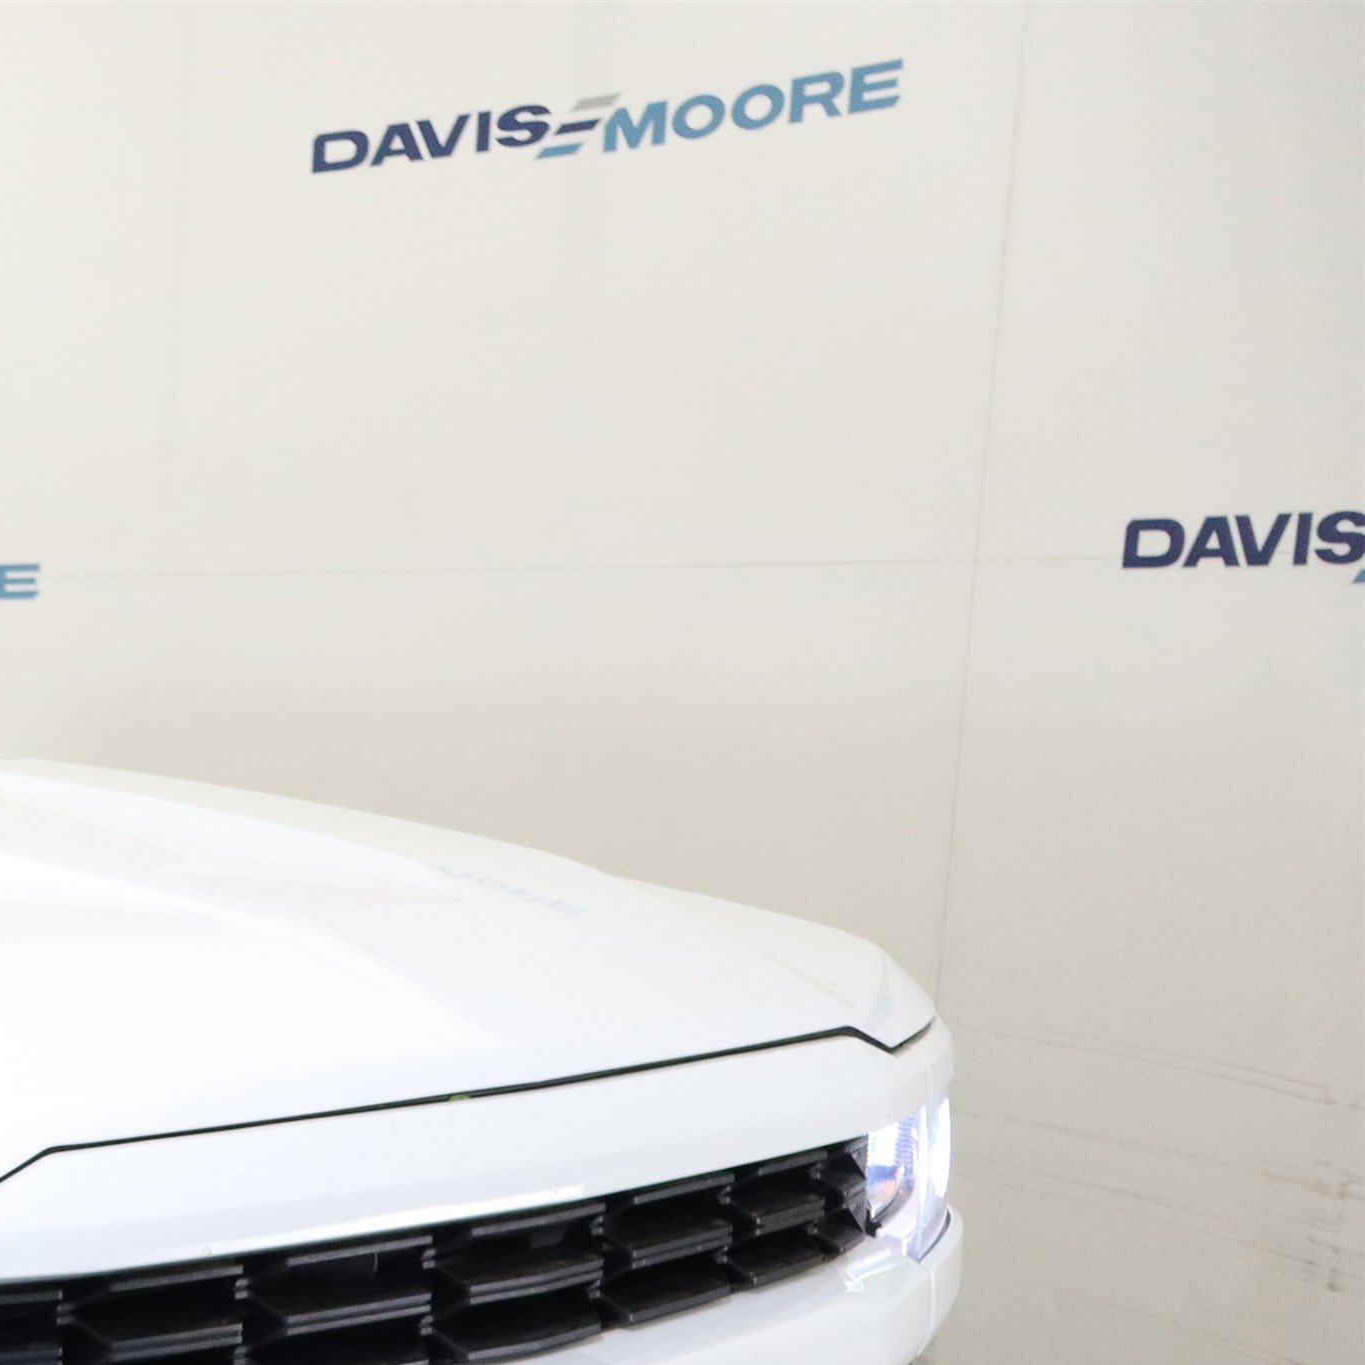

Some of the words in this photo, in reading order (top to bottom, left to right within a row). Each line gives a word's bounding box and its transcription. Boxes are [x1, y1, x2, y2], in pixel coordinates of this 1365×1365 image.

[311, 104, 552, 174] DAVIS
[602, 58, 904, 153] MOORE
[1122, 510, 1365, 569] DAVIS
